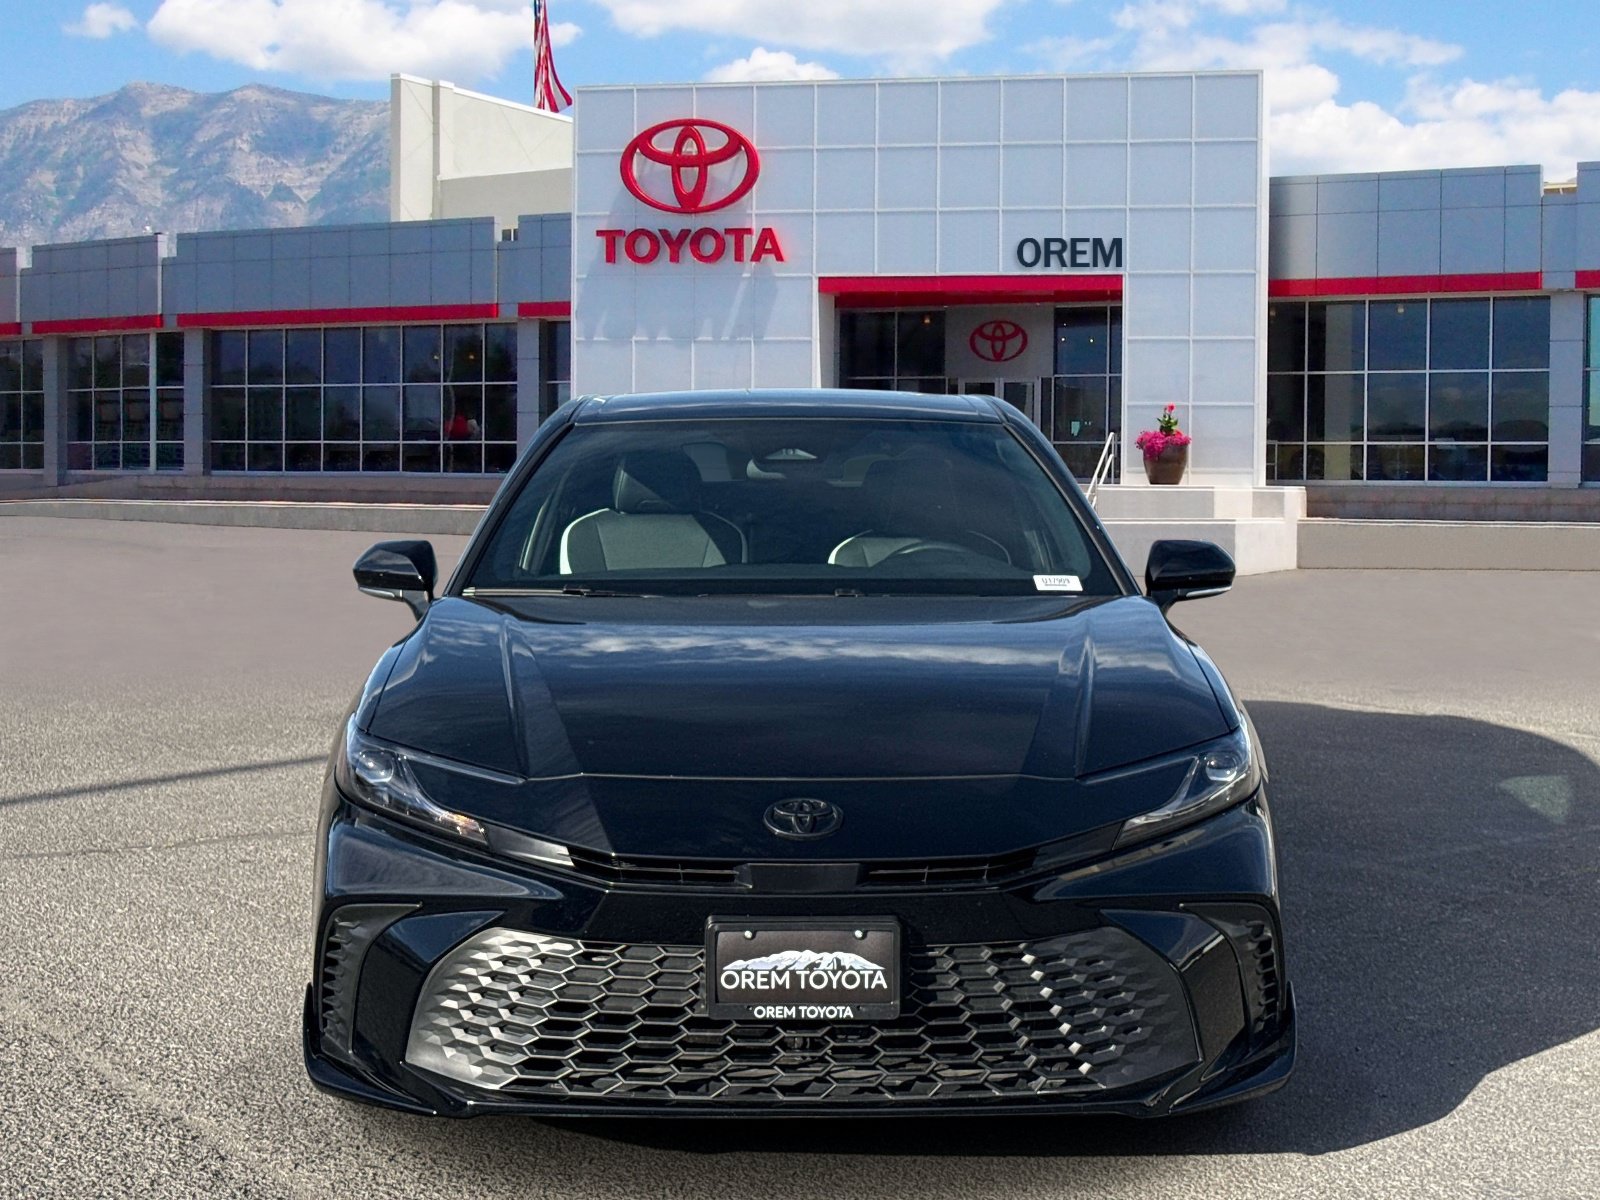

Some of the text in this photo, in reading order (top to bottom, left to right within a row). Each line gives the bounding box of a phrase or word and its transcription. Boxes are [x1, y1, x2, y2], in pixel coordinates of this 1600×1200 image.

[596, 227, 785, 265] TOYOTA
[1017, 237, 1123, 268] OREM
[720, 970, 888, 990] OREM TOYOTA
[753, 1005, 854, 1019] OREM TOYOTA
